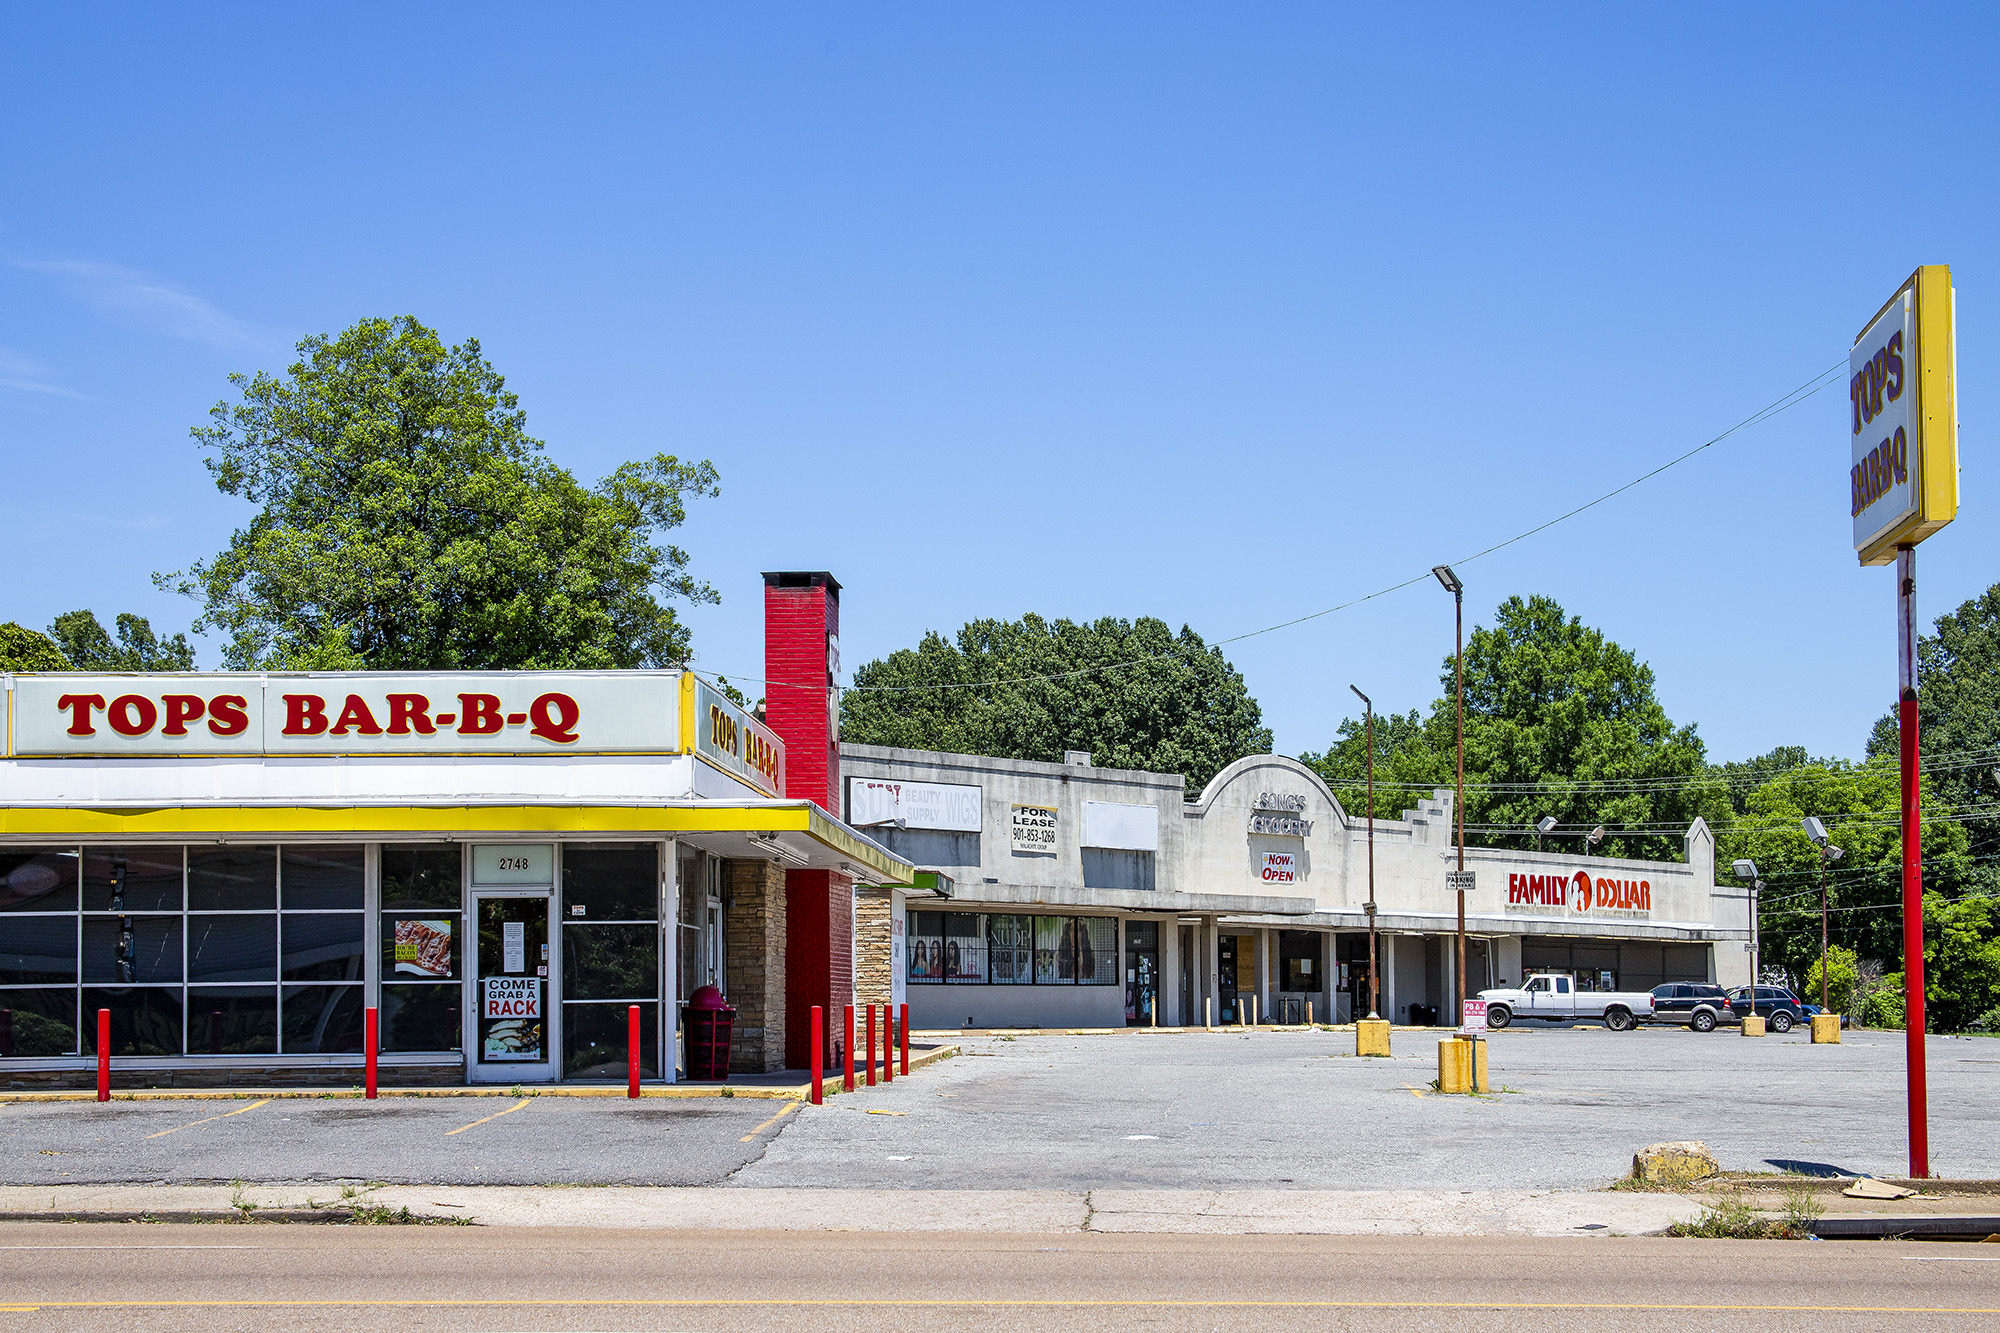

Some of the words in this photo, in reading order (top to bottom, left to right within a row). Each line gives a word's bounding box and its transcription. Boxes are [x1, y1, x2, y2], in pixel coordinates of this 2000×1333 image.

[1851, 329, 1904, 436] TOPS
[58, 693, 249, 736] TOPS
[281, 692, 580, 743] BAR-B-Q
[709, 703, 737, 758] TOPS
[744, 726, 779, 791] BAR-B-Q
[905, 789, 941, 804] BEAUTY
[1258, 792, 1306, 812] SONG'S
[907, 807, 940, 821] SUPPLY
[945, 791, 979, 825] WIGS
[1021, 806, 1048, 817] FOR
[1013, 816, 1055, 828] LEASE
[1250, 816, 1315, 837] GROCERY
[1013, 828, 1055, 843] 901-853-1268
[499, 857, 529, 870] 2748
[1268, 854, 1290, 866] NOW
[1262, 867, 1294, 881] OPEN
[1509, 873, 1569, 906] FAMILY
[1596, 877, 1651, 911] DOLLAR
[489, 979, 535, 990] COME
[489, 990, 523, 999] GRAB
[527, 990, 536, 999] A
[489, 1000, 537, 1015] RACK
